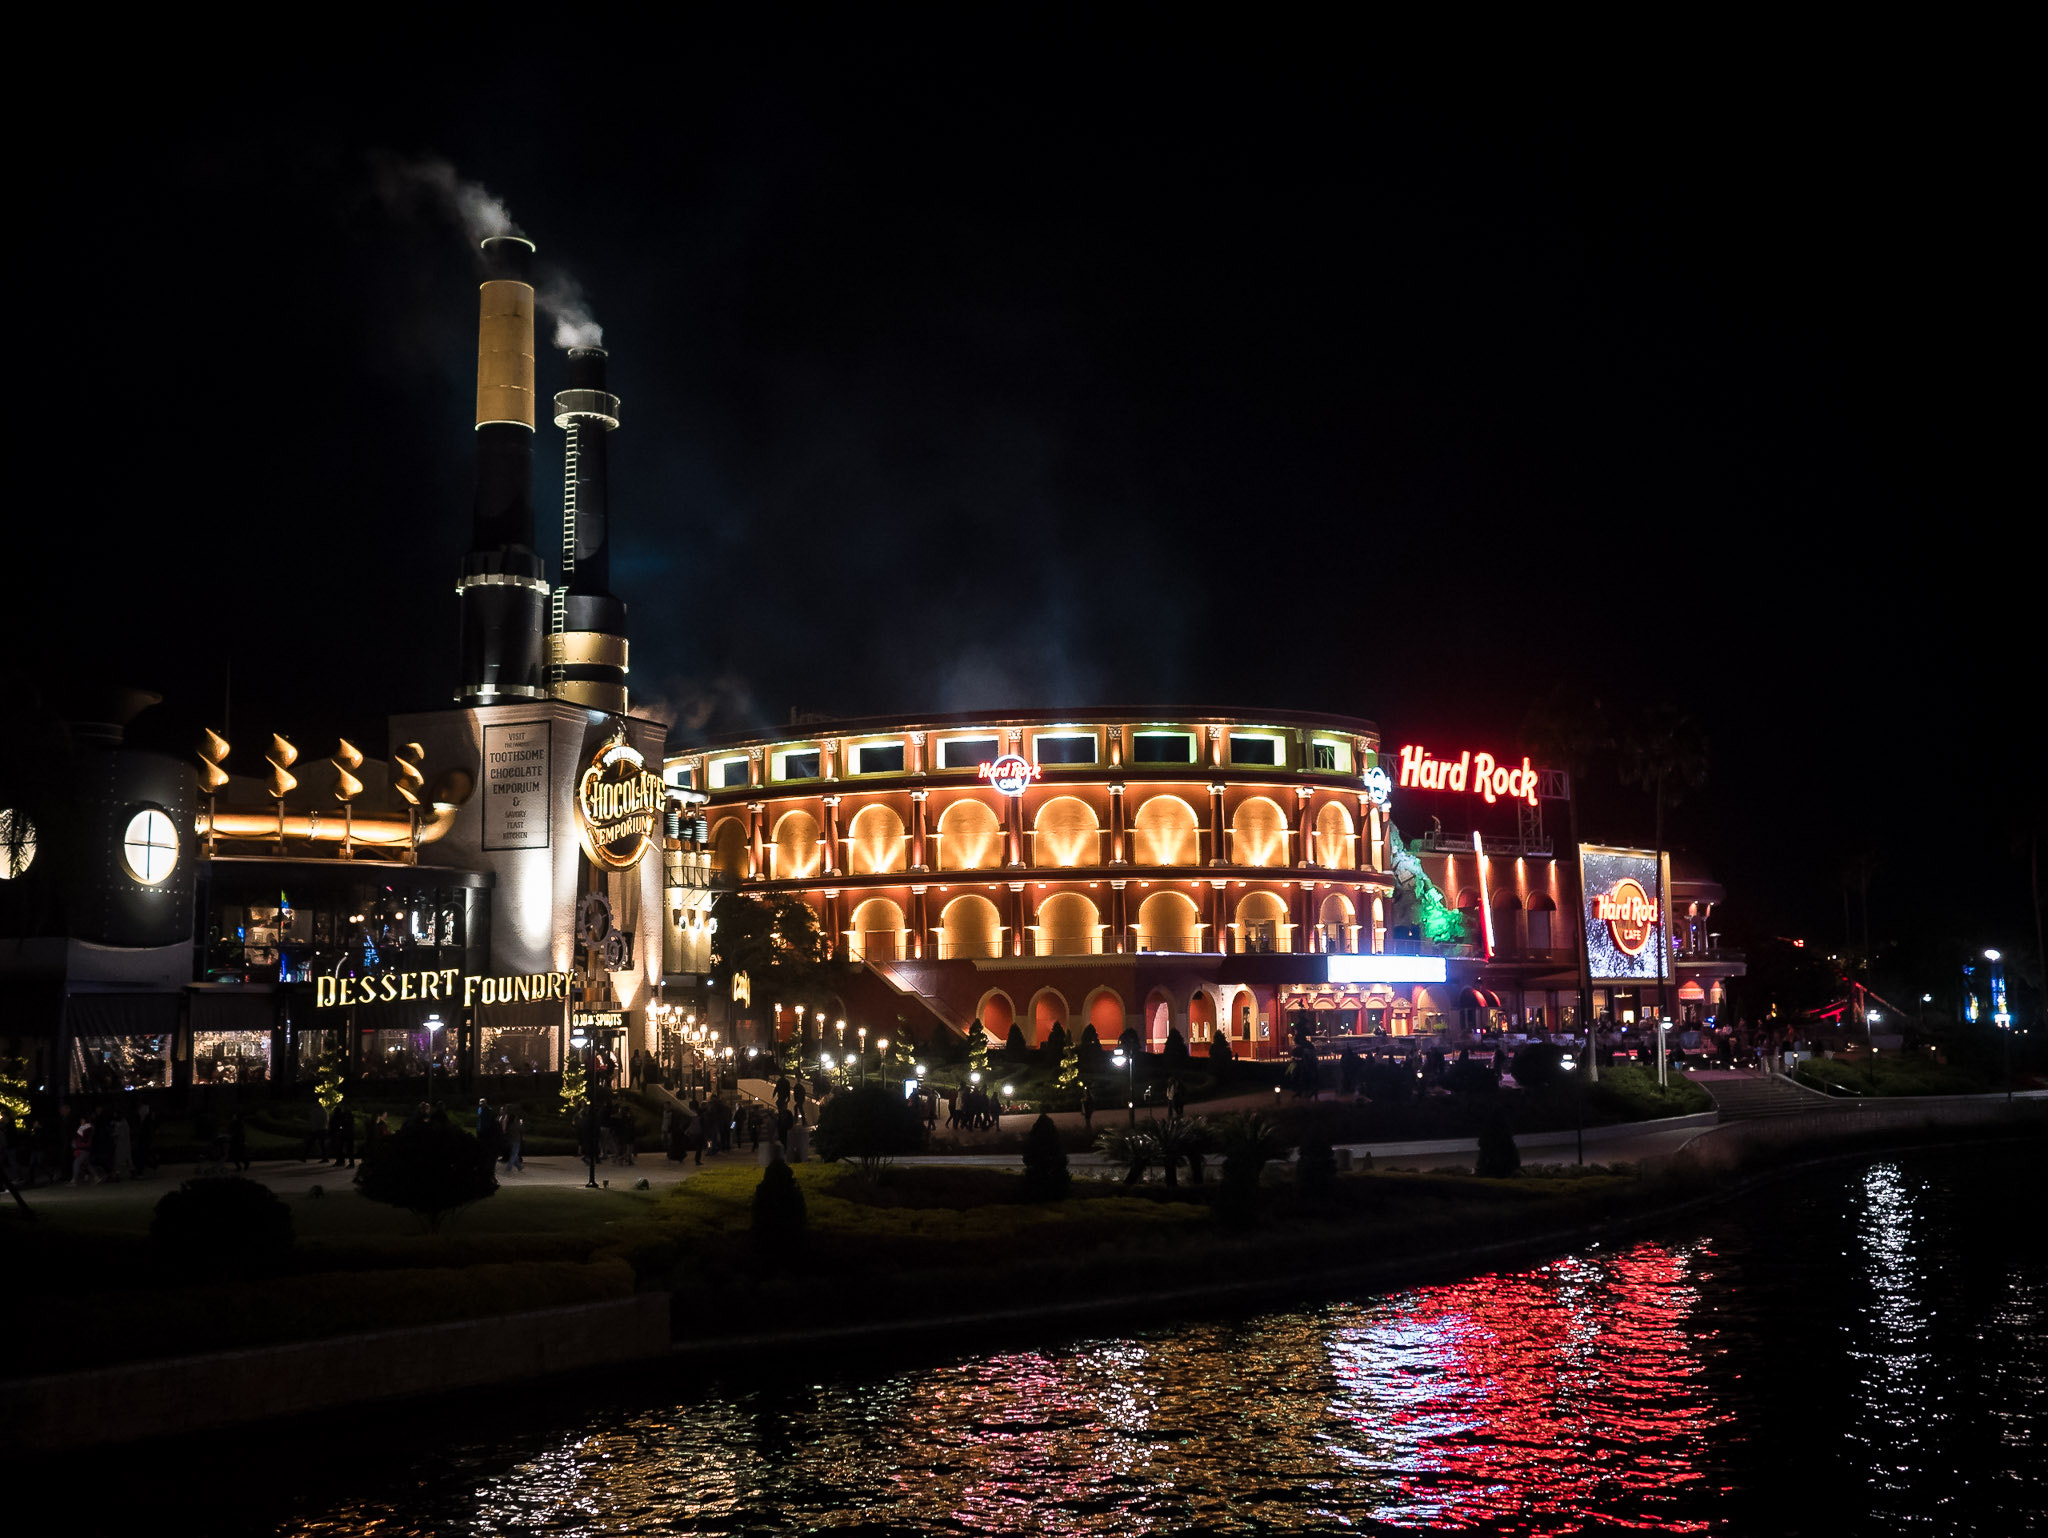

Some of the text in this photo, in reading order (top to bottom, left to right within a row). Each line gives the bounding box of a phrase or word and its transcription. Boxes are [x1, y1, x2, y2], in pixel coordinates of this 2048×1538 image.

[508, 732, 525, 741] VISIT
[490, 749, 545, 763] TOOTHSOME
[490, 765, 543, 779] CHOCOLATE
[978, 761, 1041, 780] Hard Rock
[1400, 745, 1538, 806] Hard Rock
[493, 781, 540, 795] EMPORIUM
[512, 796, 520, 807] &
[580, 766, 667, 827] CHOCOLATE
[599, 816, 649, 847] EMPORIUM
[1598, 895, 1631, 921] Hard
[1624, 929, 1642, 941] CAFE
[316, 968, 574, 1008] DESSERT FOUNDRY
[595, 1013, 622, 1027] SPIRITS
